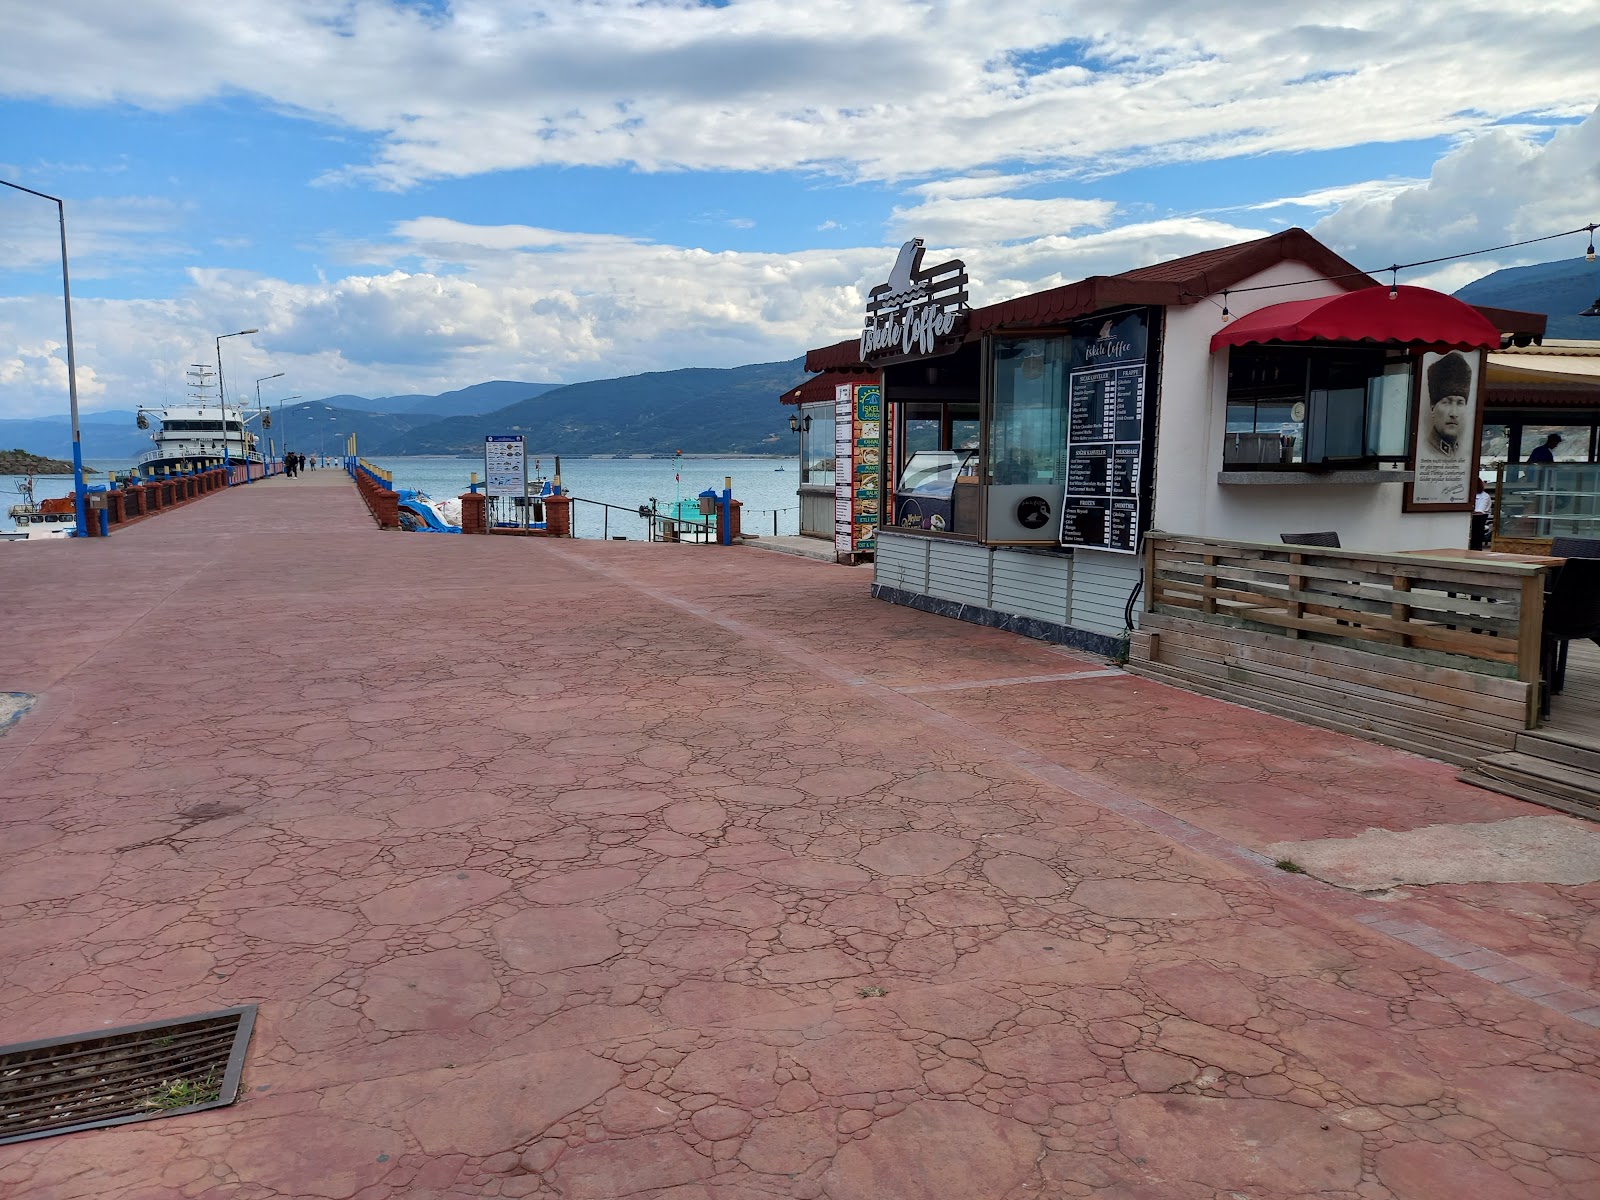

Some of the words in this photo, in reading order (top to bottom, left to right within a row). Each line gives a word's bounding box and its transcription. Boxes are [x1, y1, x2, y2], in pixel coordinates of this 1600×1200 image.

[902, 304, 957, 355] Coffee
[1107, 340, 1131, 358] Coffee
[862, 404, 880, 412] İSKEL
